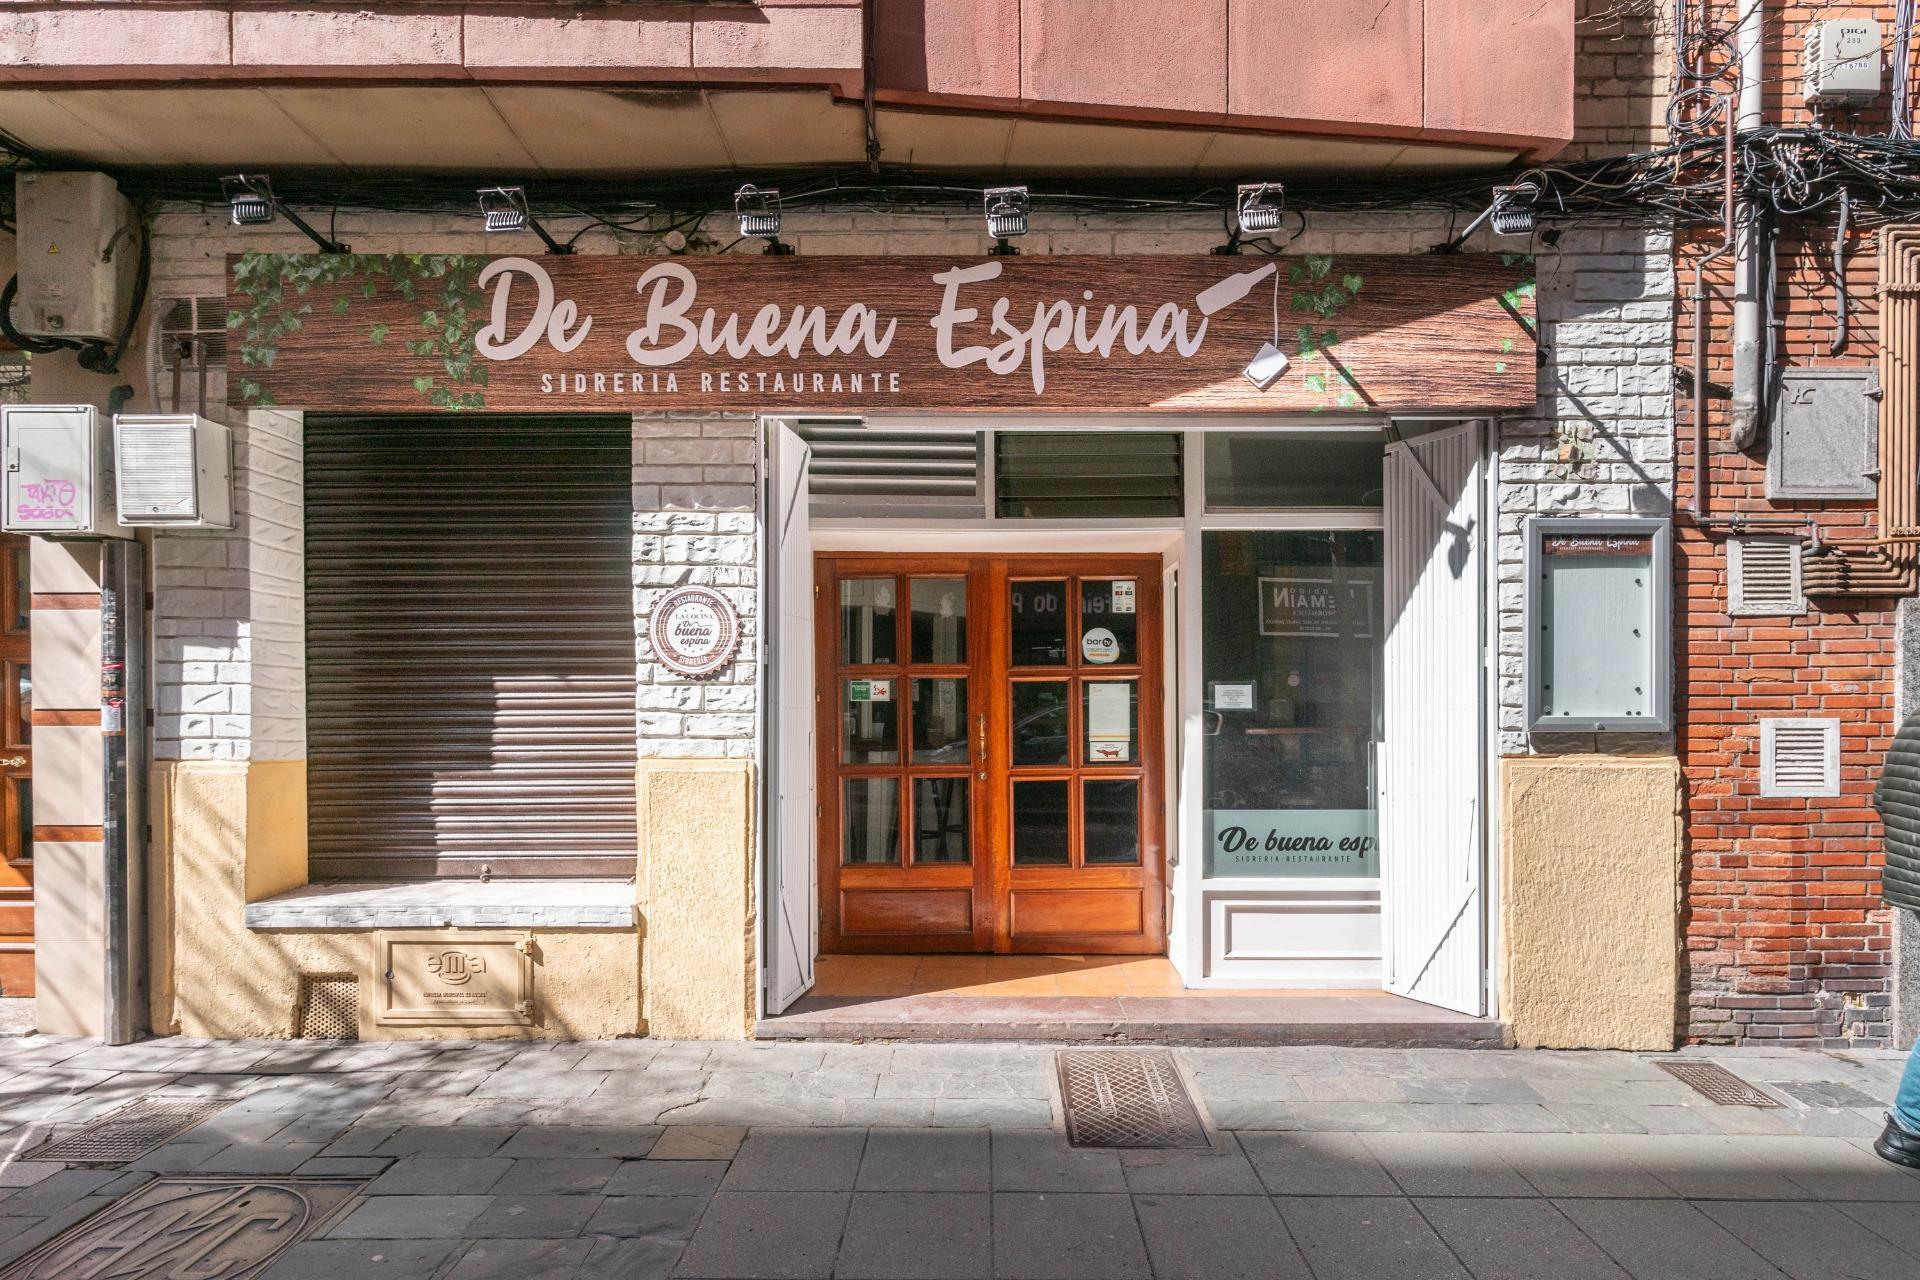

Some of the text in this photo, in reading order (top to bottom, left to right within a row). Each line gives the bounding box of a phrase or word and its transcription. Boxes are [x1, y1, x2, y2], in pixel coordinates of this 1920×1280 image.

[474, 256, 1208, 394] De Buena Espina
[541, 372, 900, 393] SIDRERIA RESTAURANTE
[673, 595, 715, 607] RESTAURANTE
[674, 623, 712, 636] buena
[680, 637, 710, 647] espina
[1218, 826, 1259, 852] De
[1264, 829, 1333, 851] buena
[1236, 855, 1351, 863] SIDRERIA RESTAURANTE
